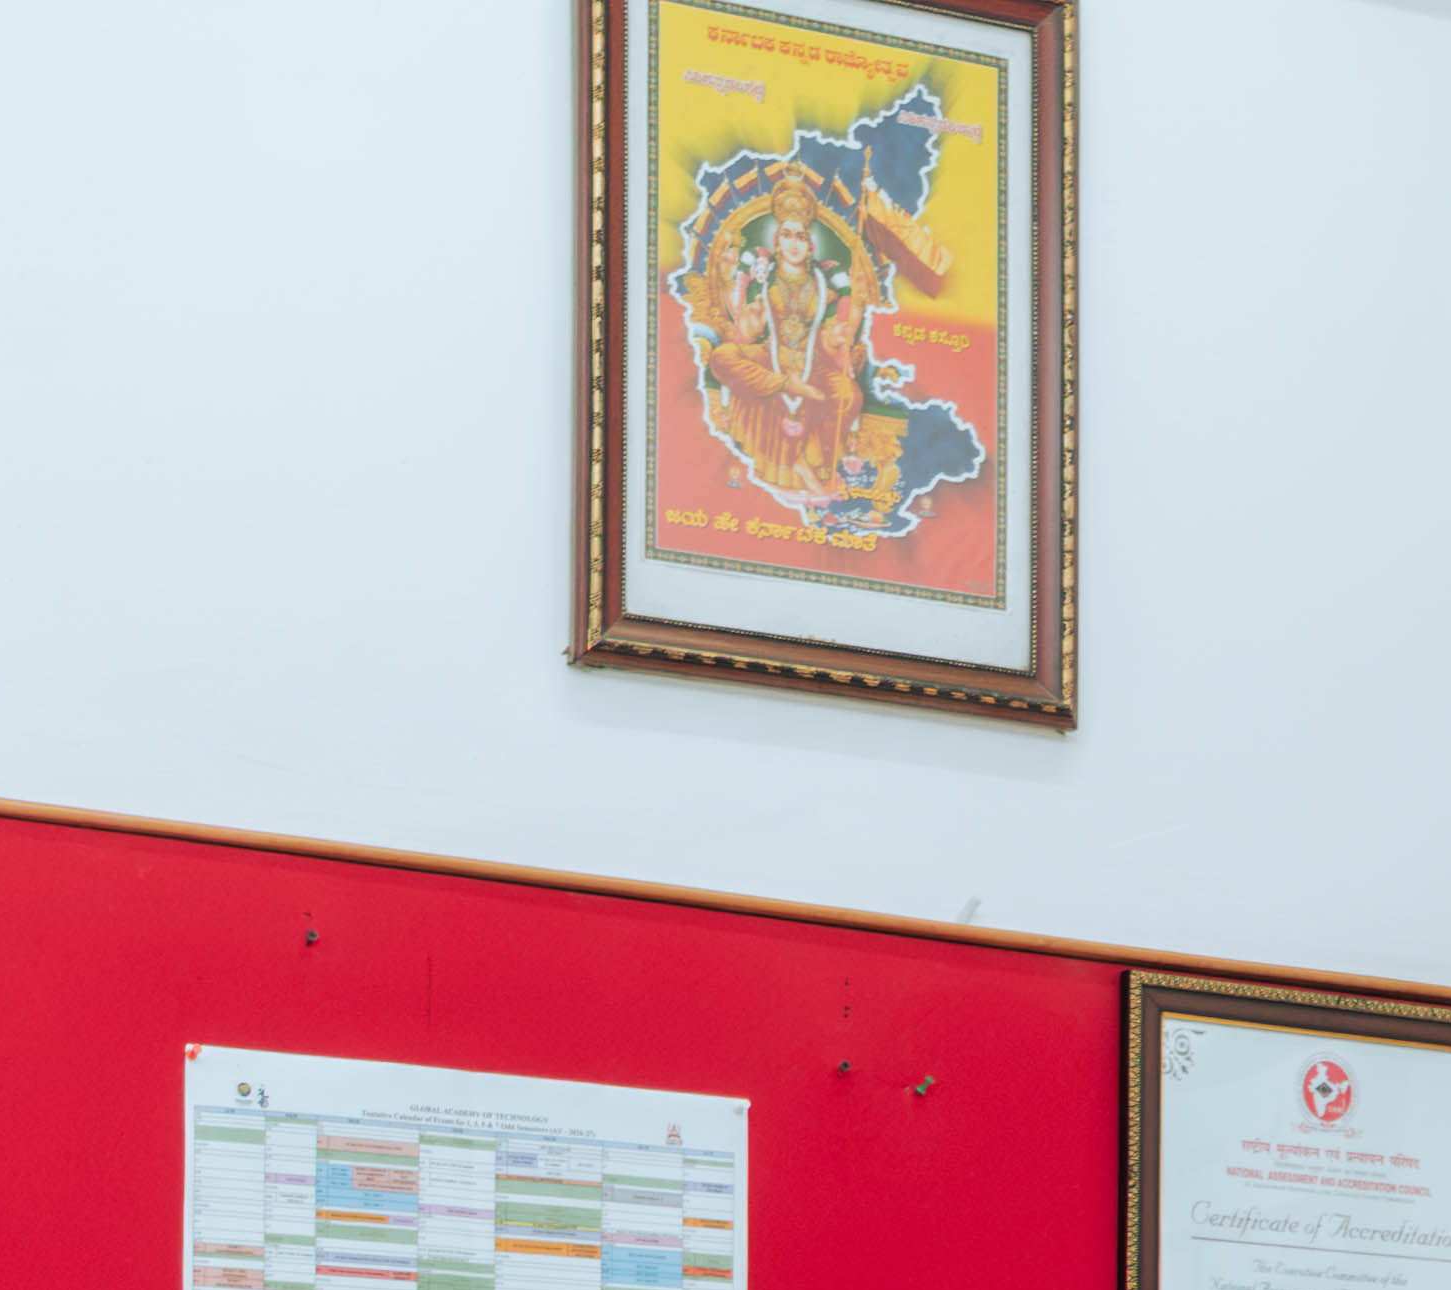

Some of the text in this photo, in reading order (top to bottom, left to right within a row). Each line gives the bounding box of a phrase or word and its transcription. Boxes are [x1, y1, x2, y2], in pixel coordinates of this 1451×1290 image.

[745, 517, 828, 545] ಕರ್ನಾಟಕ
[1226, 1165, 1264, 1181] NATIONAL
[1190, 1199, 1300, 1238] Certificate
[1304, 1212, 1327, 1244] of
